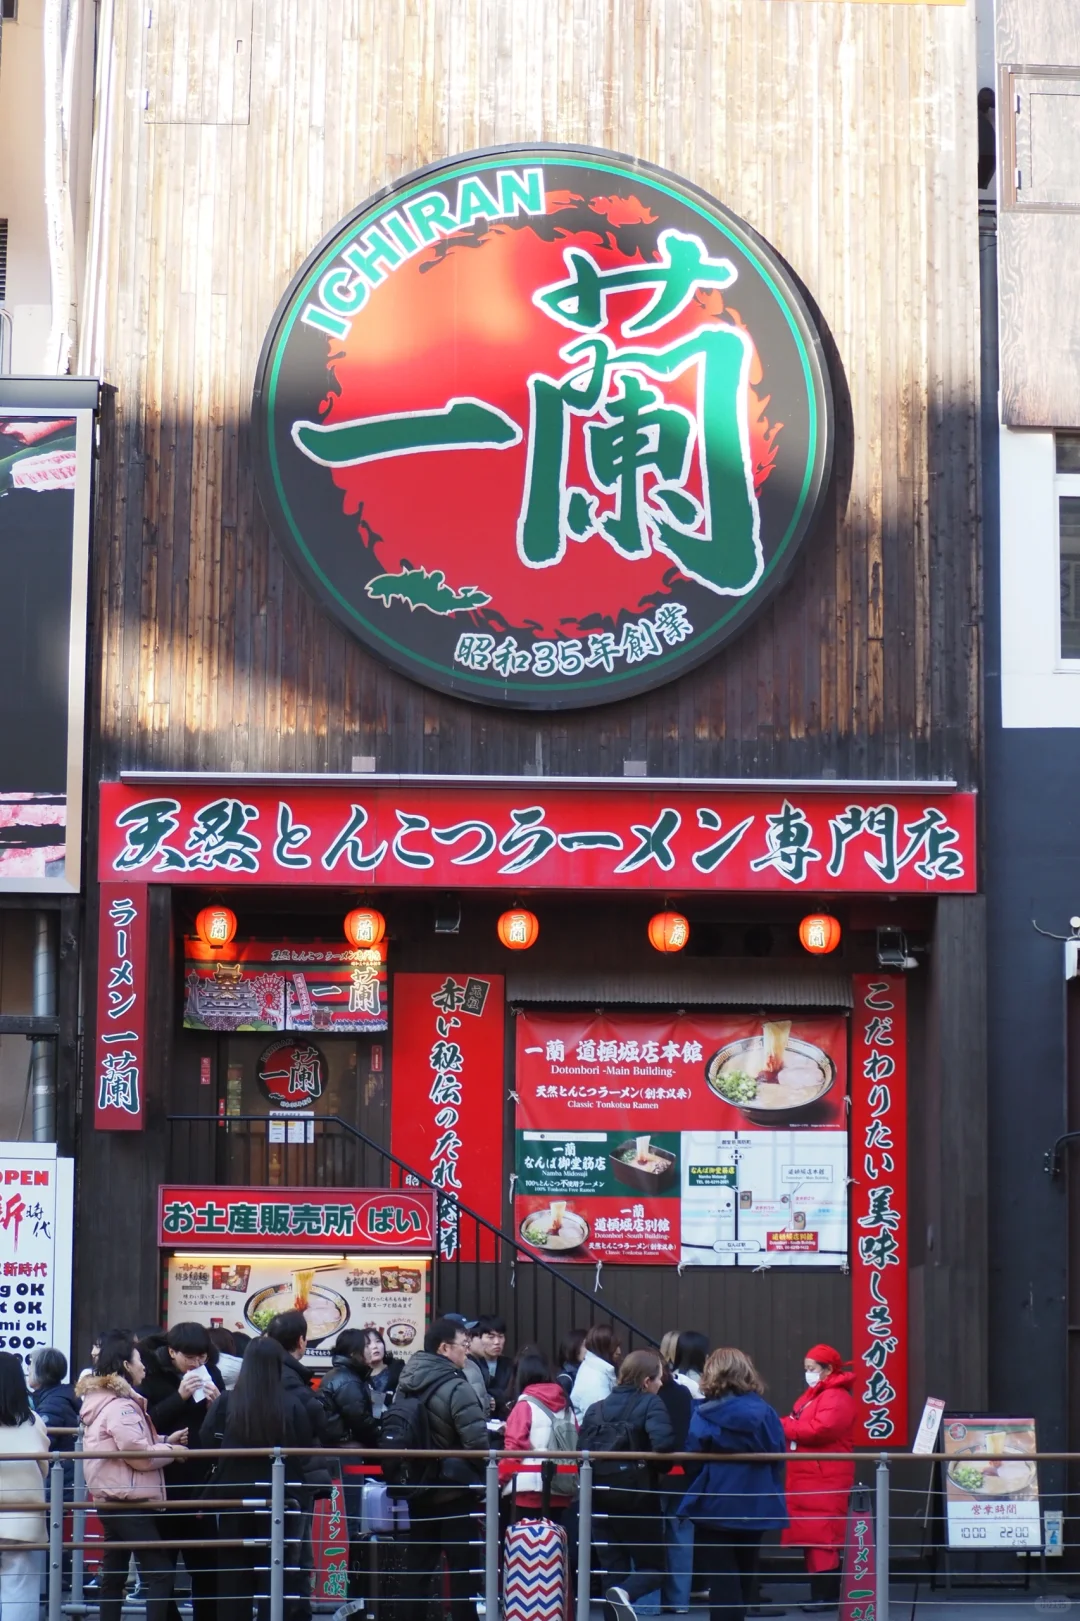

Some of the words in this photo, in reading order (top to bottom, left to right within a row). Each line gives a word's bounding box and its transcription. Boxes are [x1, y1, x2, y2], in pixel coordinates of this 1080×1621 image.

[300, 167, 546, 341] ICHIRAN
[291, 228, 765, 597] 一蘭
[453, 602, 695, 678] 昭和35年創業
[112, 798, 966, 884] 天然とんこつラーメン専門店
[210, 911, 227, 939] 一蘭
[357, 913, 373, 941] 一蘭
[509, 914, 527, 943] 一蘭
[671, 917, 686, 946] 一蘭
[808, 919, 825, 948] 一蘭
[108, 897, 138, 1020] ラーメン
[311, 966, 381, 1016] 一蘭
[525, 1039, 565, 1062] 一蘭
[576, 1039, 703, 1063] 道頓堀店本館
[97, 1030, 140, 1115] 一蘭
[259, 1047, 322, 1098] 一蘭
[551, 1065, 600, 1075] Dotonbori
[603, 1066, 630, 1076] -Main
[633, 1066, 676, 1078] Building-
[567, 1100, 593, 1109] Classic
[596, 1101, 631, 1109] Tonkotsu
[633, 1102, 659, 1110] Ramen
[552, 1142, 576, 1156] 一蘭
[524, 1156, 606, 1171] なんば御堂筋店
[563, 1170, 588, 1178] Midosuji
[163, 1201, 355, 1237] お土産販売所
[367, 1206, 422, 1234] ばい
[620, 1203, 645, 1218] 一蘭
[857, 982, 901, 1440] こだわりたい美味しさがある
[594, 1217, 670, 1233] 道頓堀店別館
[0, 1261, 48, 1277] 新時代
[16, 1283, 45, 1296] OK
[14, 1301, 42, 1314] OK
[26, 1320, 47, 1331] ok
[971, 1504, 1017, 1515] 営業時間
[853, 1520, 869, 1581] ラーメン
